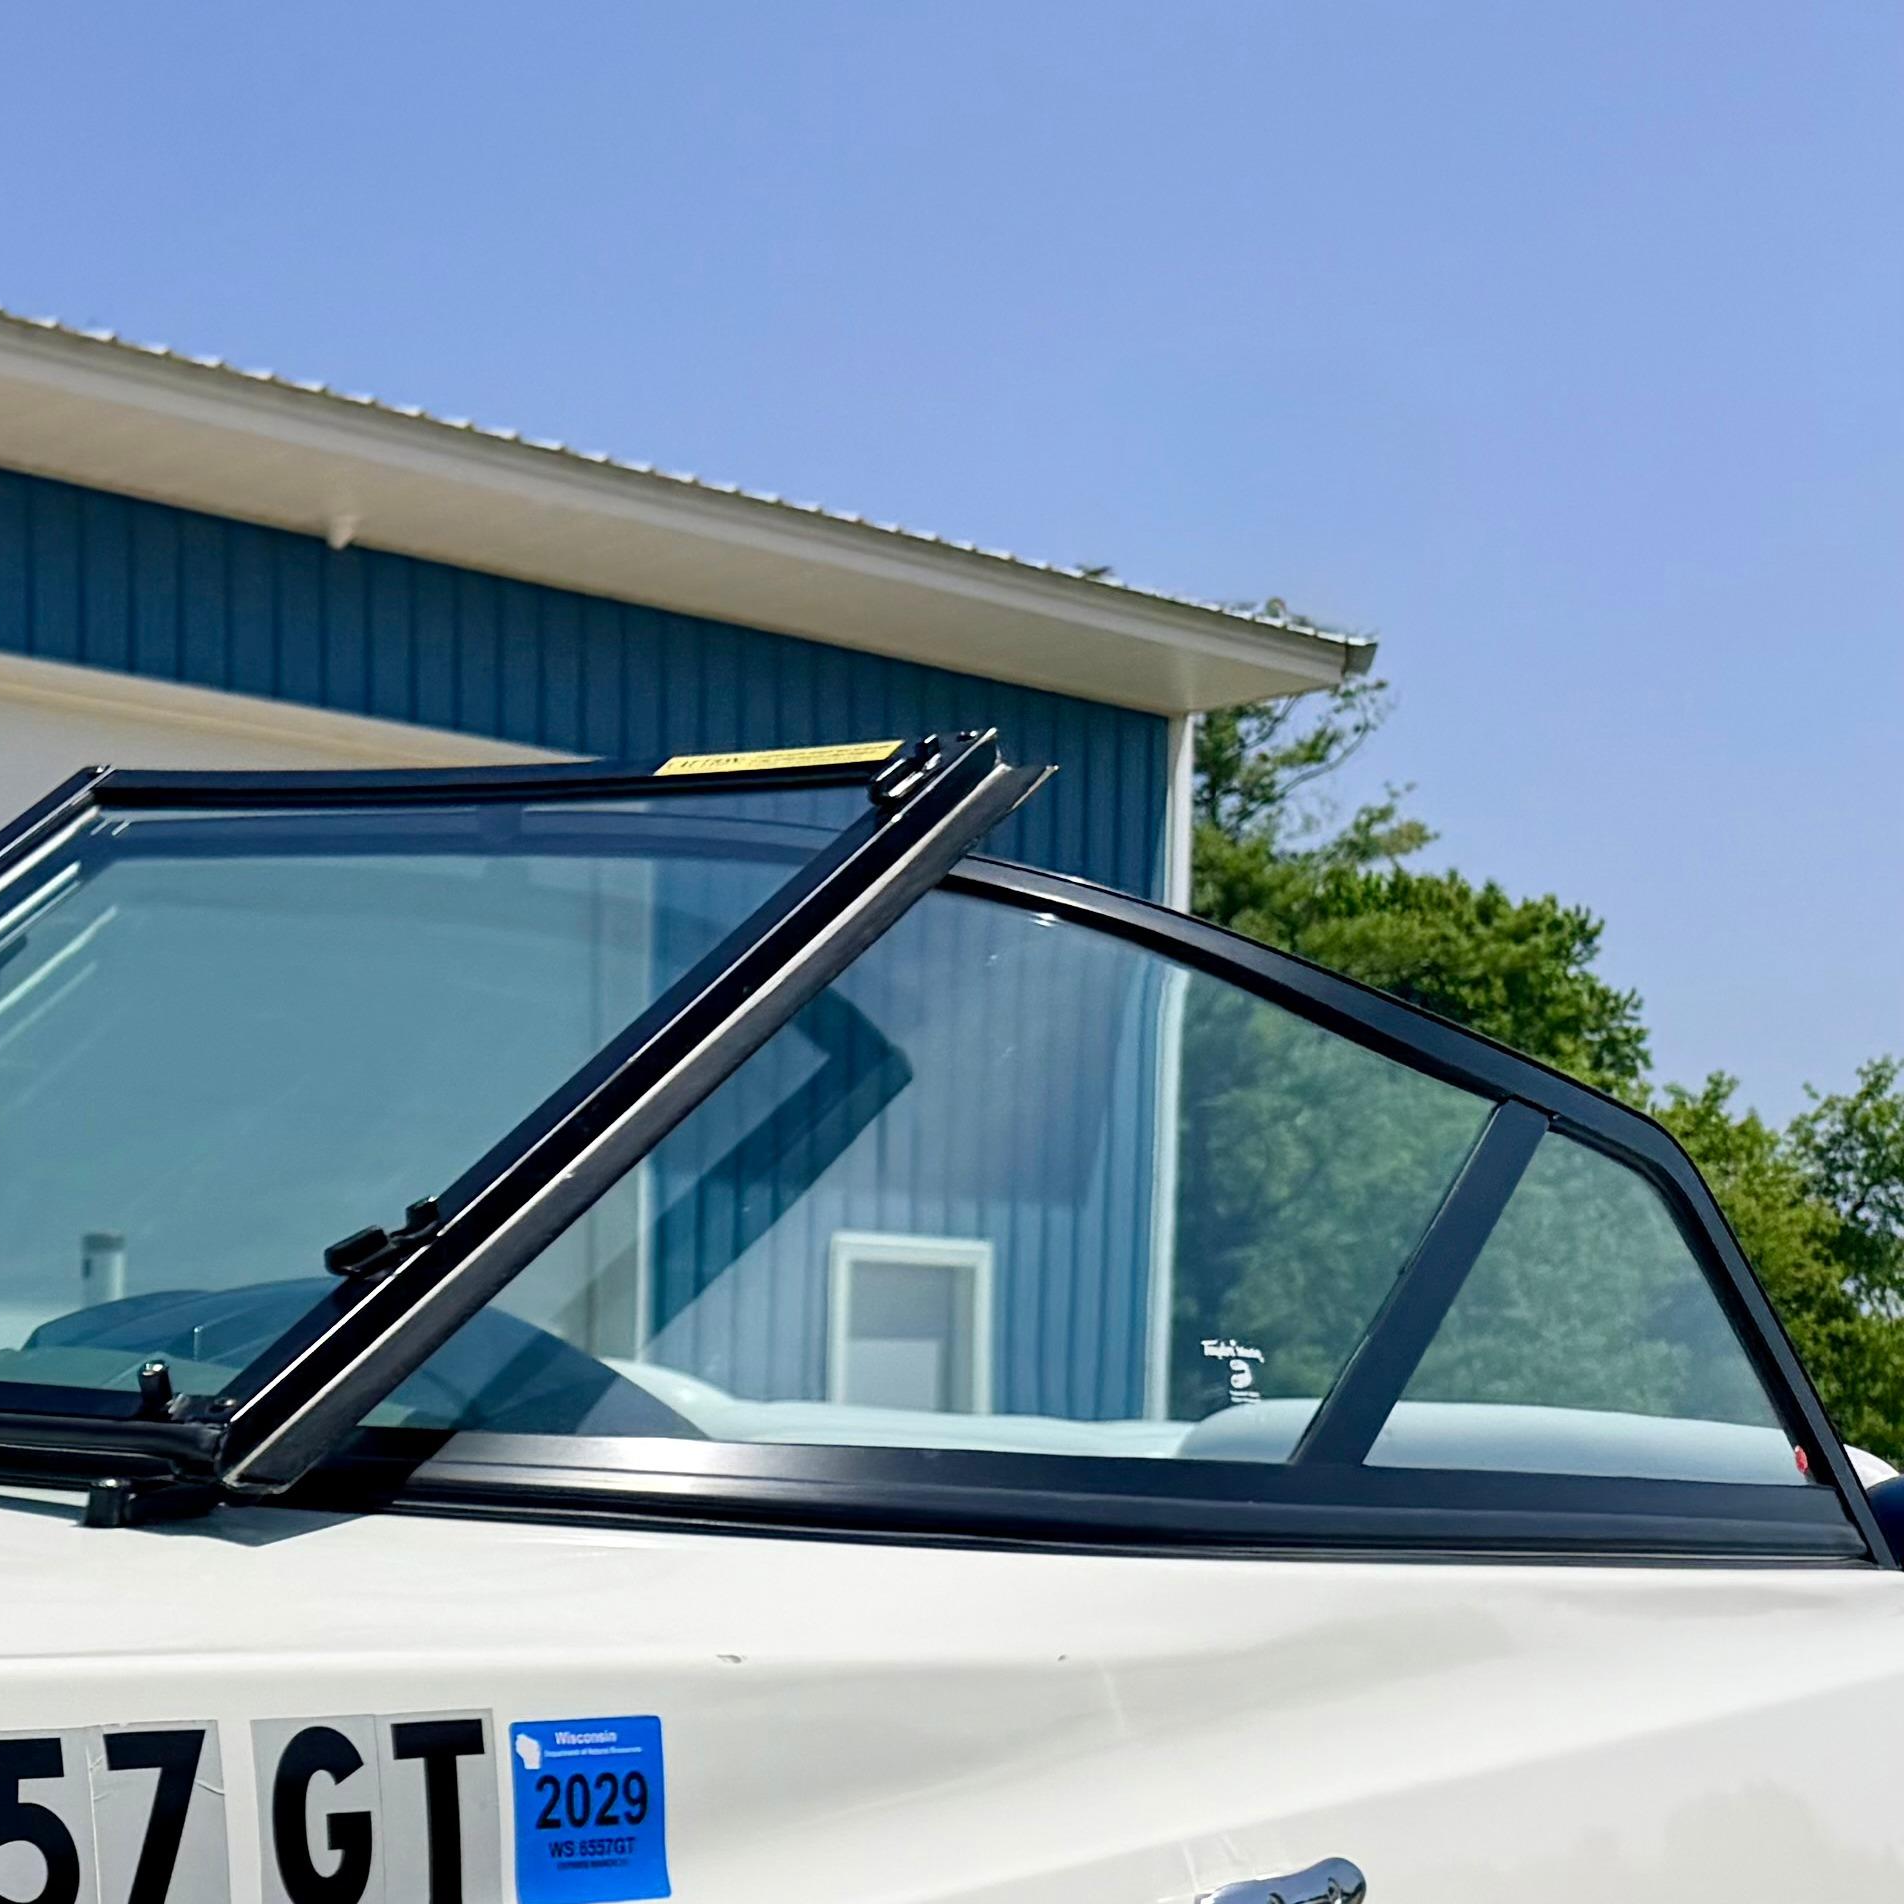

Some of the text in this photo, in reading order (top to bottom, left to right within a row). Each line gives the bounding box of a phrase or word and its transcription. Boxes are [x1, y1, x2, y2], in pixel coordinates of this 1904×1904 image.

[554, 1730, 618, 1745] Wisconsin
[535, 1769, 649, 1829] 2029
[548, 1840, 575, 1858] WS
